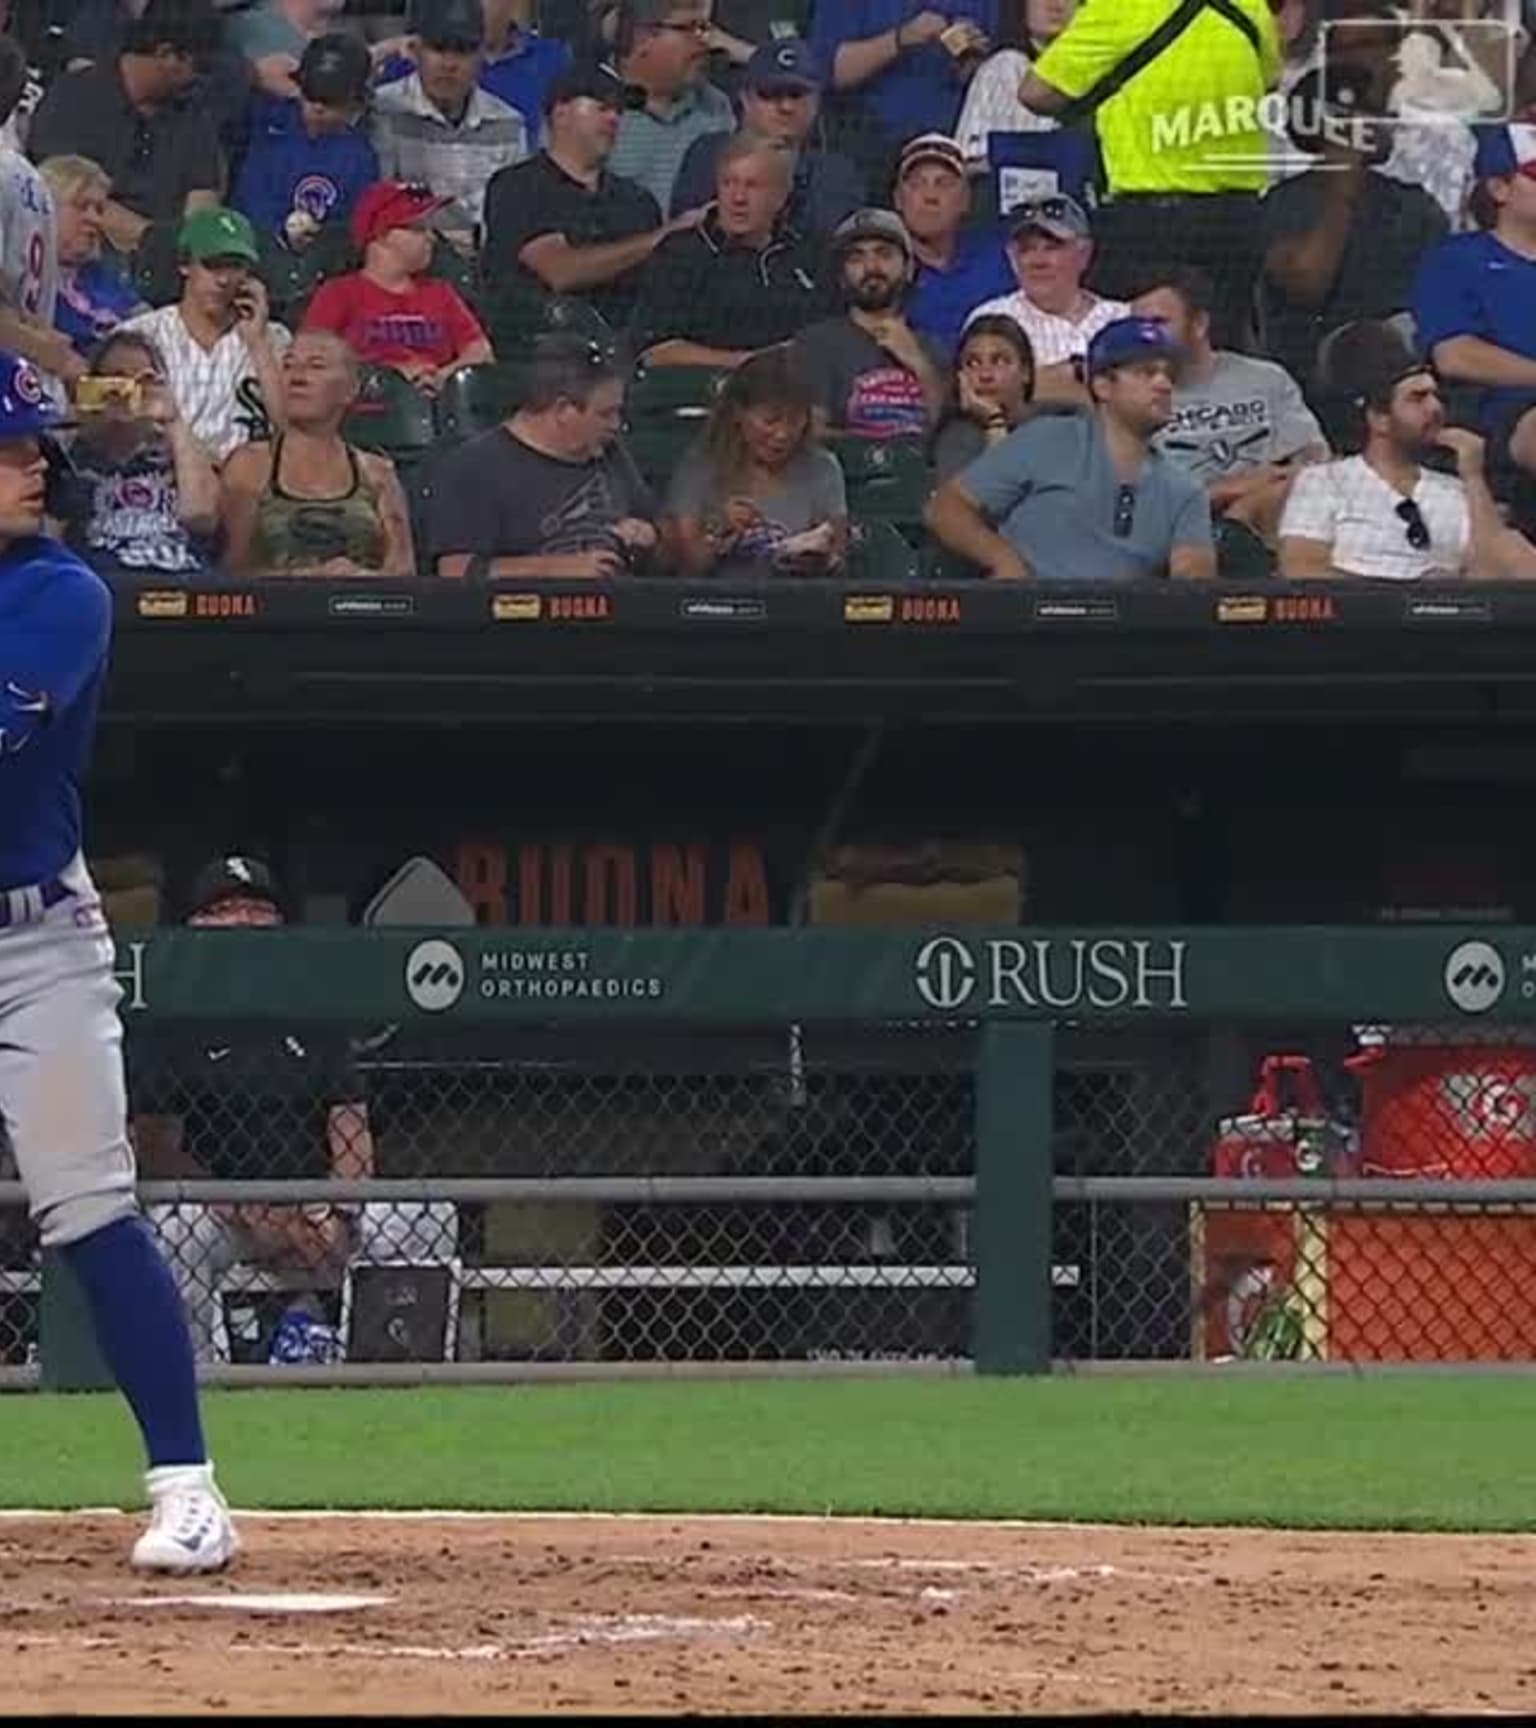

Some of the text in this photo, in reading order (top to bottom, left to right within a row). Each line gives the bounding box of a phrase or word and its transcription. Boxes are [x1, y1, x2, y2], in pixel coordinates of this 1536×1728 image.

[196, 594, 255, 616] BUONA
[549, 595, 609, 617] BUONA
[901, 597, 960, 620] BUONA
[1276, 597, 1334, 620] BUONA
[481, 952, 589, 970] MIDWEST
[986, 939, 1189, 1008] RUSH
[479, 979, 661, 997] ORTHOPAEDICS
